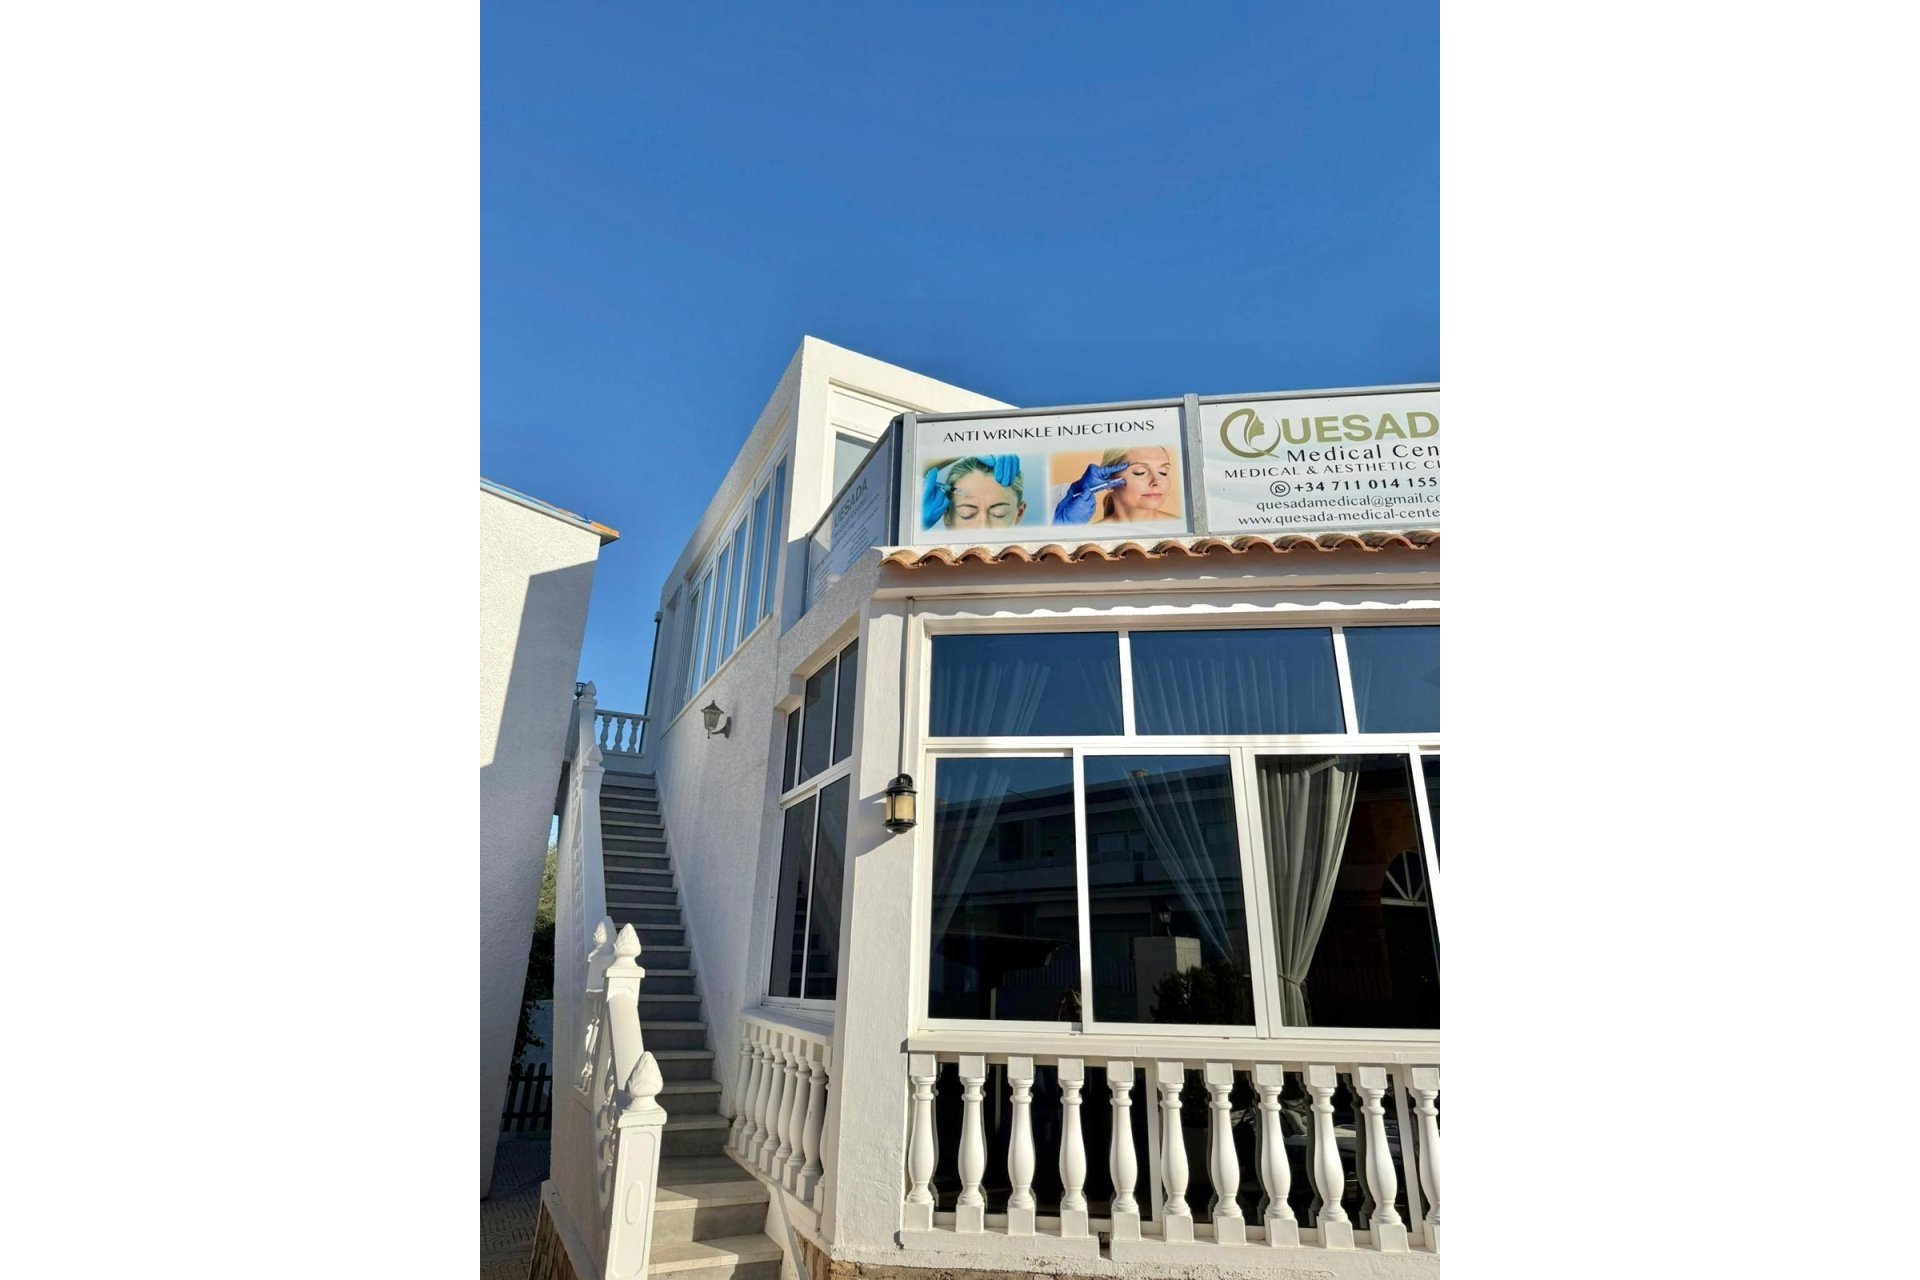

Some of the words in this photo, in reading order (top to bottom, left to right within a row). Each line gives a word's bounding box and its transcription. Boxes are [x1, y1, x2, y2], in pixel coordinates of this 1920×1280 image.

[943, 430, 979, 442] ANTI
[982, 426, 1052, 440] WRINKLE
[1057, 419, 1155, 436] INJECTIONS
[1287, 444, 1382, 463] Medical
[1392, 444, 1440, 458] Cen
[1224, 466, 1300, 479] MEDICAL
[1306, 465, 1318, 475] &
[1324, 461, 1416, 473] AESTHETIC
[1294, 481, 1325, 492] +34
[1332, 480, 1361, 491] 711
[1368, 478, 1400, 489] 014
[1409, 477, 1437, 488] 155
